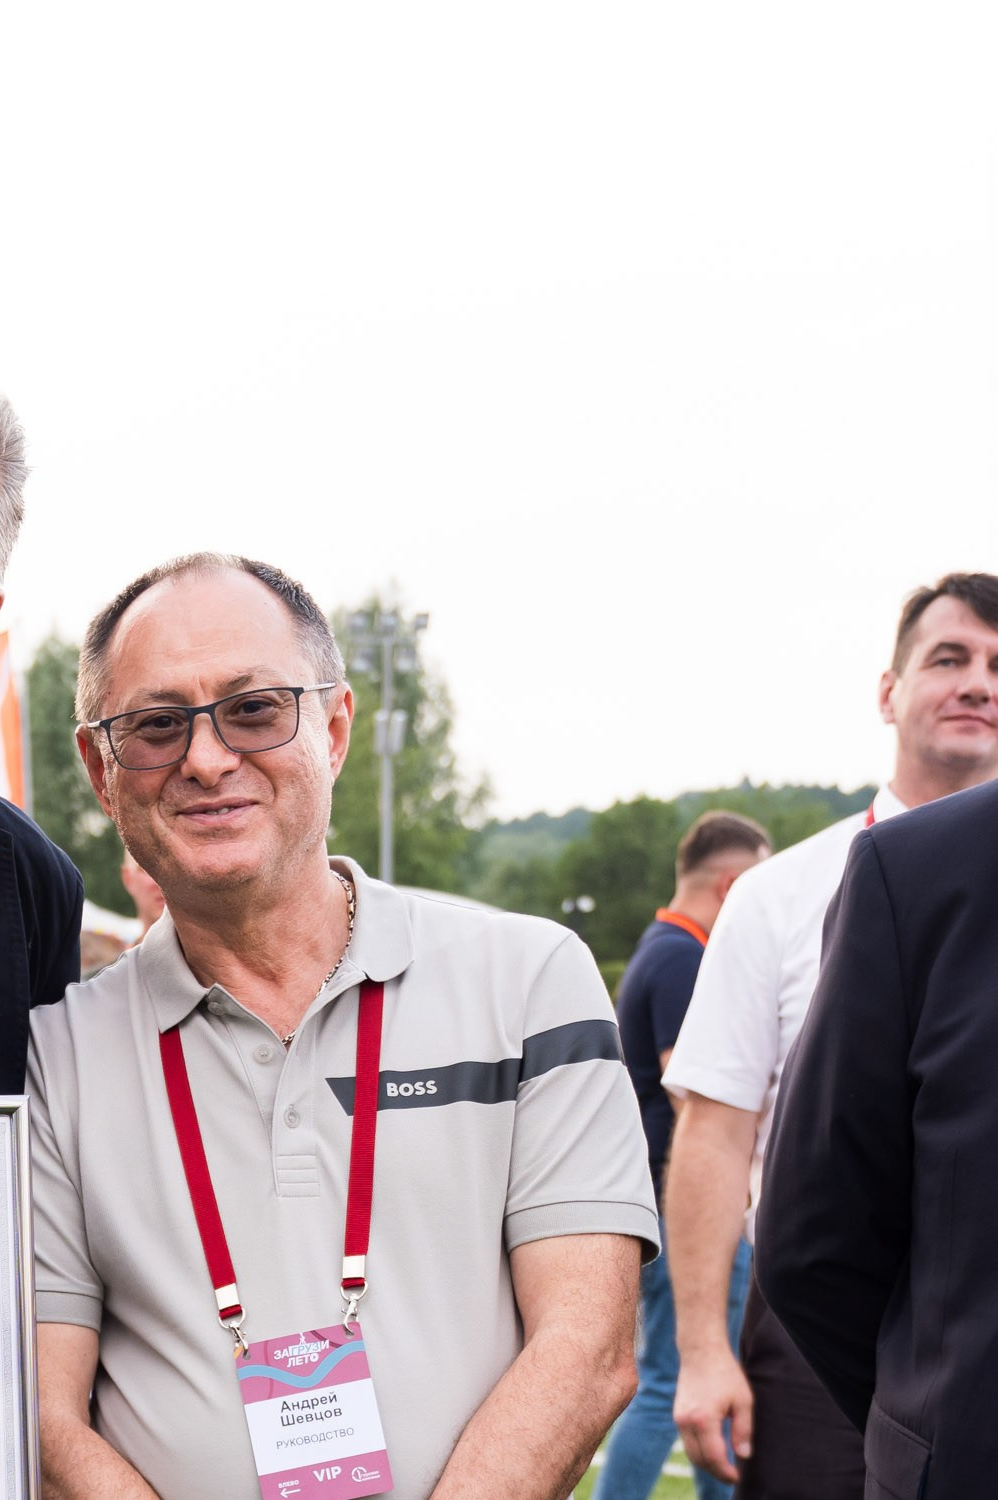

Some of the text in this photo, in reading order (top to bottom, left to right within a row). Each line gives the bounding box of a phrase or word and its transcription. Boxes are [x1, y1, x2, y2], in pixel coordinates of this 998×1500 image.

[386, 1080, 438, 1097] BOSS
[274, 1339, 330, 1360] ЗАГРУЗИ
[287, 1352, 319, 1368] ЛЕТО
[280, 1391, 337, 1413] Андрей
[280, 1407, 342, 1427] Шевцов
[276, 1427, 355, 1450] РУКОВОДСТВО
[313, 1466, 342, 1482] VIP
